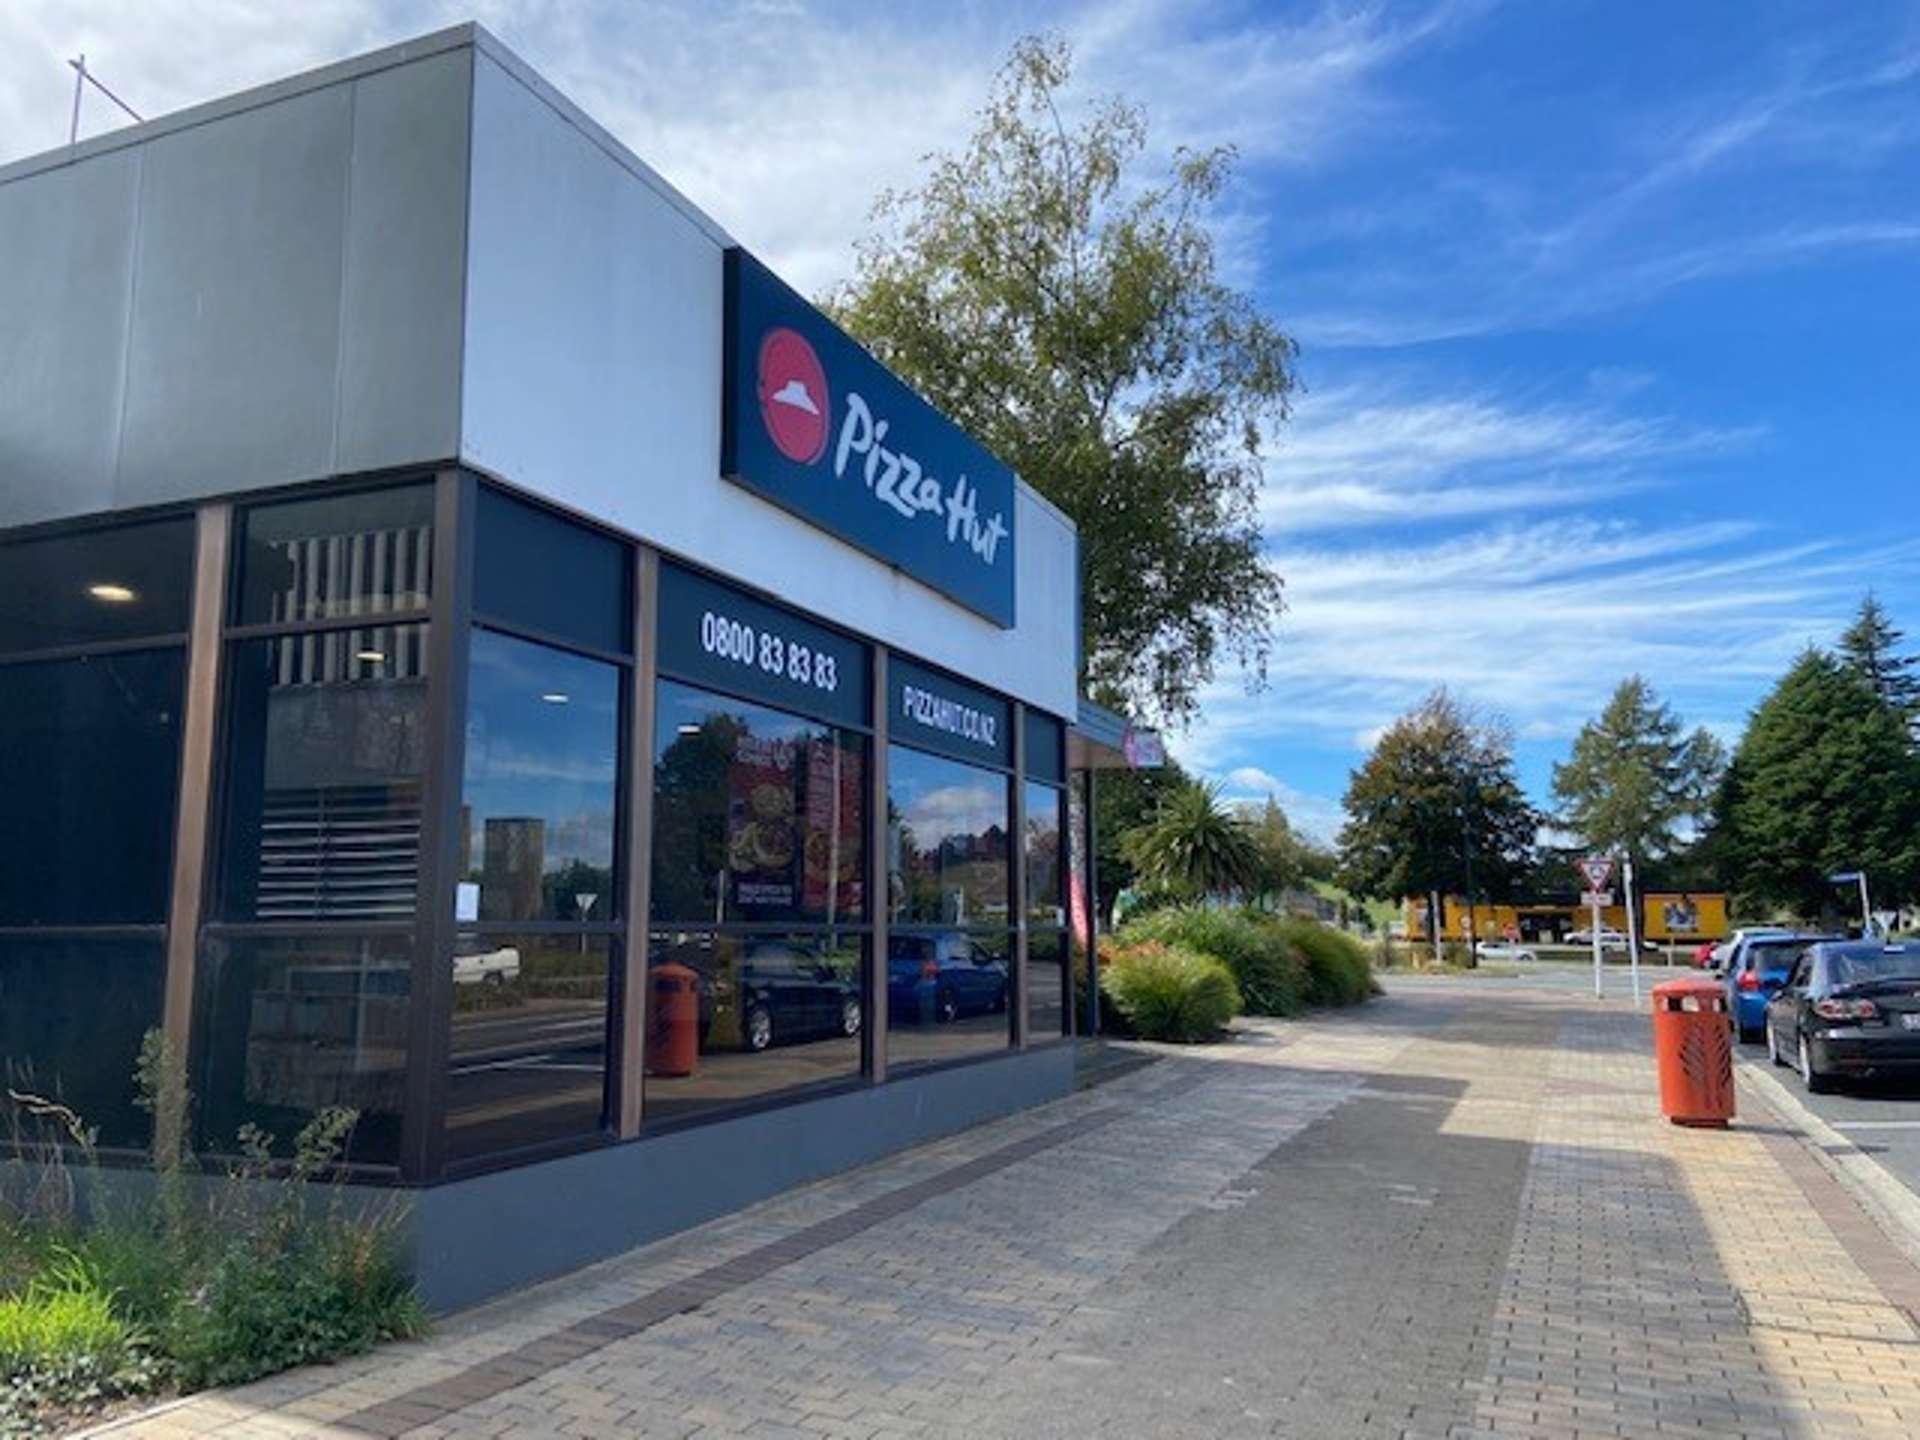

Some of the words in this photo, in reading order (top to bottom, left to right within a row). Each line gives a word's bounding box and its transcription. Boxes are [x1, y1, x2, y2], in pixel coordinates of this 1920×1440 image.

[834, 392, 944, 519] Pizza
[945, 473, 1008, 566] Hut
[702, 611, 754, 665] 0800
[759, 632, 784, 675] 83
[788, 642, 811, 683] 83
[815, 652, 837, 691] 83
